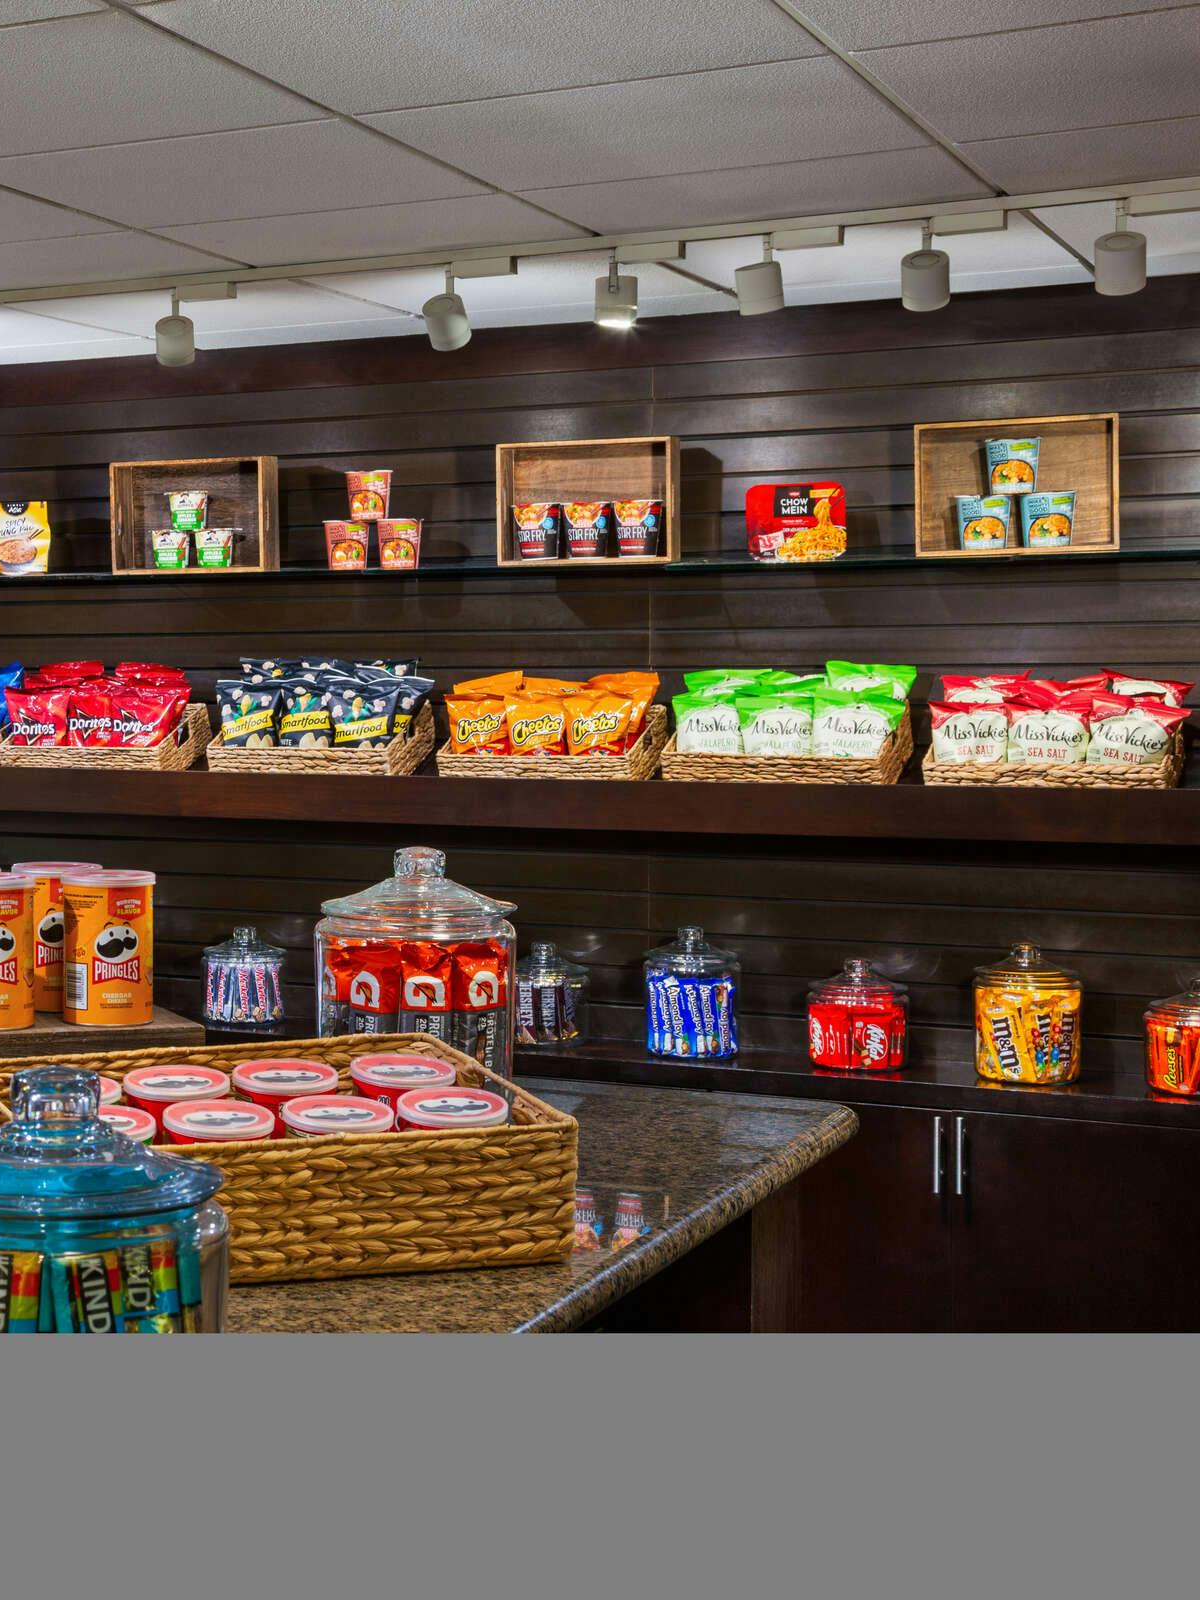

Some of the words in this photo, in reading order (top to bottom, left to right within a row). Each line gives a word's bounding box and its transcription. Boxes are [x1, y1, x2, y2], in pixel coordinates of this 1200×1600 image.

[780, 498, 809, 506] CHOW
[781, 505, 808, 515] MEIN
[518, 529, 531, 542] STIR
[531, 528, 546, 541] FRY
[568, 528, 583, 541] STIR
[584, 527, 598, 541] FRY
[617, 527, 631, 539] STIR
[631, 526, 648, 539] FRY
[13, 722, 55, 736] Doritos
[69, 717, 112, 731] Doritos
[113, 718, 155, 732] Doritos
[335, 722, 382, 738] martfood
[458, 714, 500, 741] Cheetos
[513, 716, 561, 744] Cheetos
[573, 714, 617, 743] Cheetos
[956, 746, 974, 755] SEA
[976, 745, 994, 755] SALT
[1027, 746, 1044, 757] SEA
[1047, 748, 1067, 759] SALT
[1103, 747, 1120, 760] SEA
[1123, 750, 1144, 764] SALT
[38, 945, 64, 965] PRING
[94, 959, 140, 983] PRINGLES
[404, 975, 445, 1007] G
[80, 1258, 112, 1333] KIND
